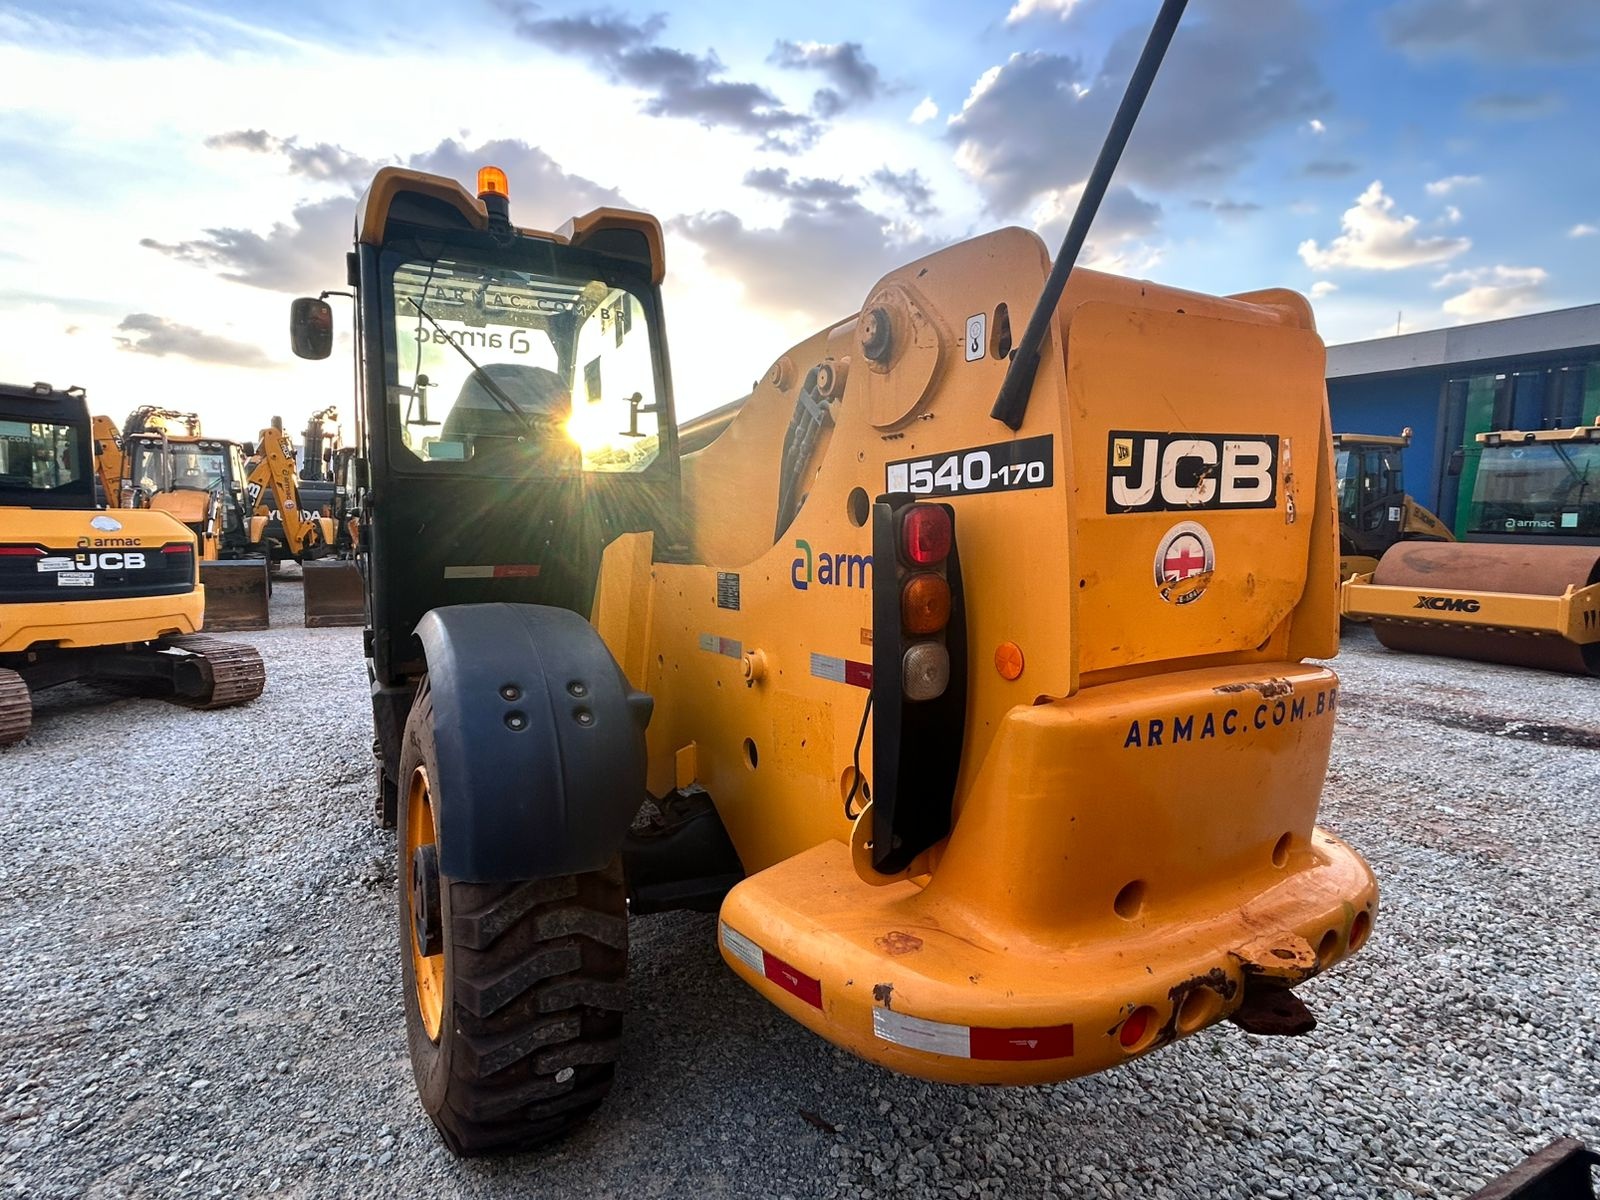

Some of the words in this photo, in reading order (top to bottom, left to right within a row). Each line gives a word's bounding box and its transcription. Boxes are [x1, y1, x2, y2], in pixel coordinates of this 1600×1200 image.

[435, 286, 626, 322] ARMAC.COM.BR
[909, 450, 1045, 495] 540-170
[1111, 438, 1273, 507] JCB
[1517, 520, 1556, 528] armac
[94, 537, 142, 547] armac
[76, 552, 146, 570] JCB
[1413, 595, 1481, 613] XCMG
[1123, 688, 1337, 749] ARMAC.COM.BR
